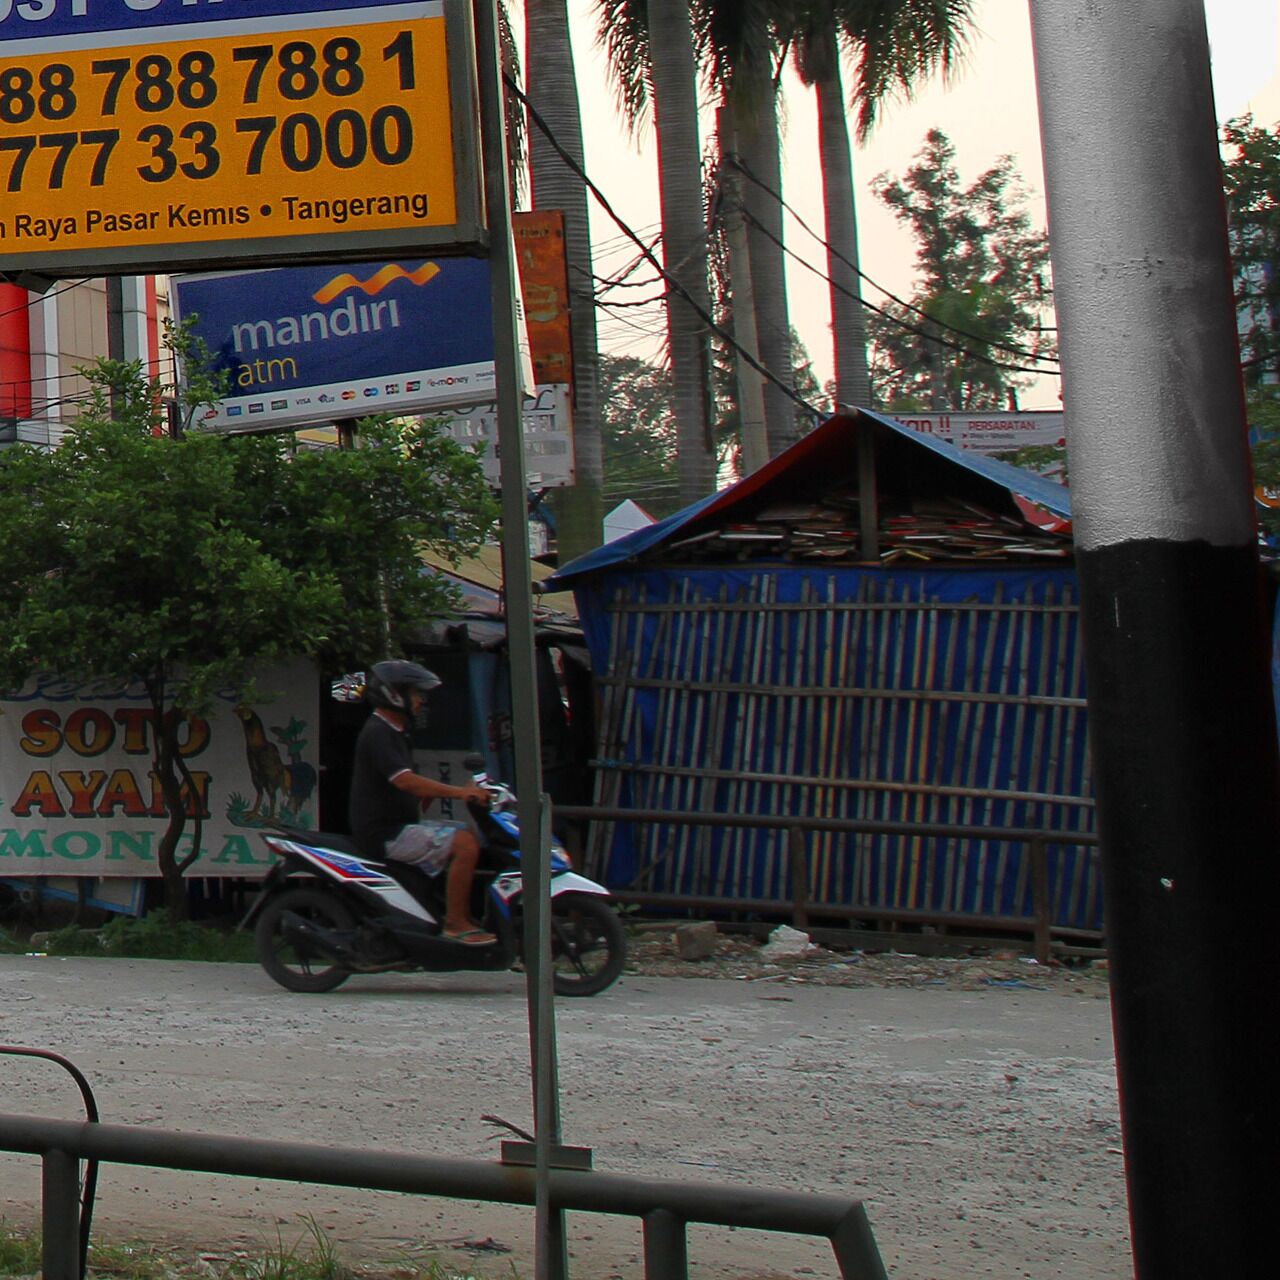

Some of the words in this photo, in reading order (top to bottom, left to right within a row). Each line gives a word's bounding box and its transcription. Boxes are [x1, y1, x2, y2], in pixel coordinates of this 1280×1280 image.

[91, 50, 218, 117] 788
[232, 36, 365, 104] 788
[382, 30, 416, 91] 1
[136, 120, 221, 184] 33
[235, 104, 414, 176] 7000
[14, 213, 78, 241] Raya
[86, 208, 162, 234] Pasar
[167, 202, 250, 230] Kemis
[282, 191, 429, 224] Tangerang
[232, 295, 401, 353] mandiri
[237, 357, 298, 387] atm
[19, 707, 212, 758] SOTO
[11, 768, 212, 819] AYAM
